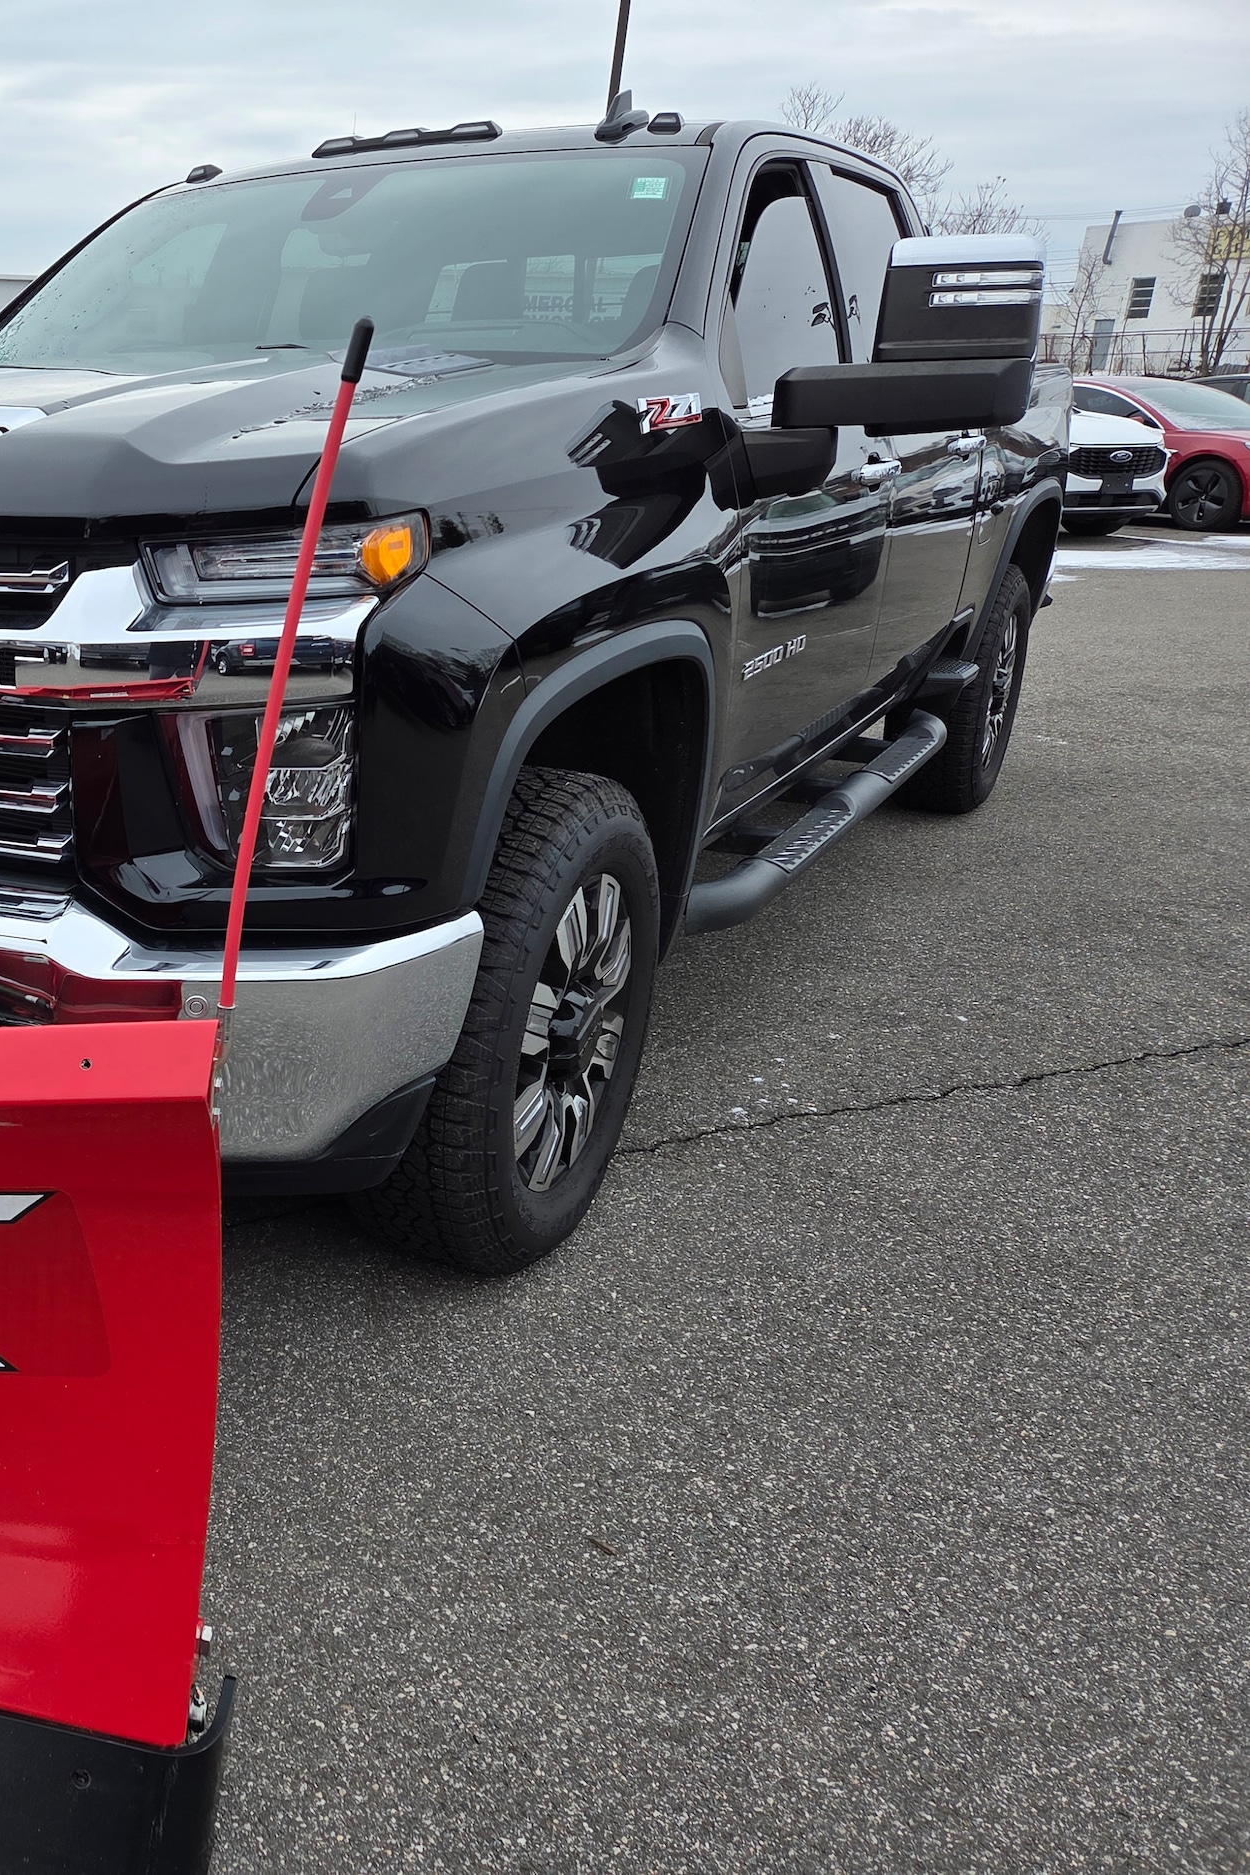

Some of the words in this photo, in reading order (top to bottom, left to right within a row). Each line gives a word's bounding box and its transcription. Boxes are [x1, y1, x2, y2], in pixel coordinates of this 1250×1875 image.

[636, 393, 703, 433] Z71
[741, 645, 784, 681] 2500
[785, 634, 807, 659] HD
